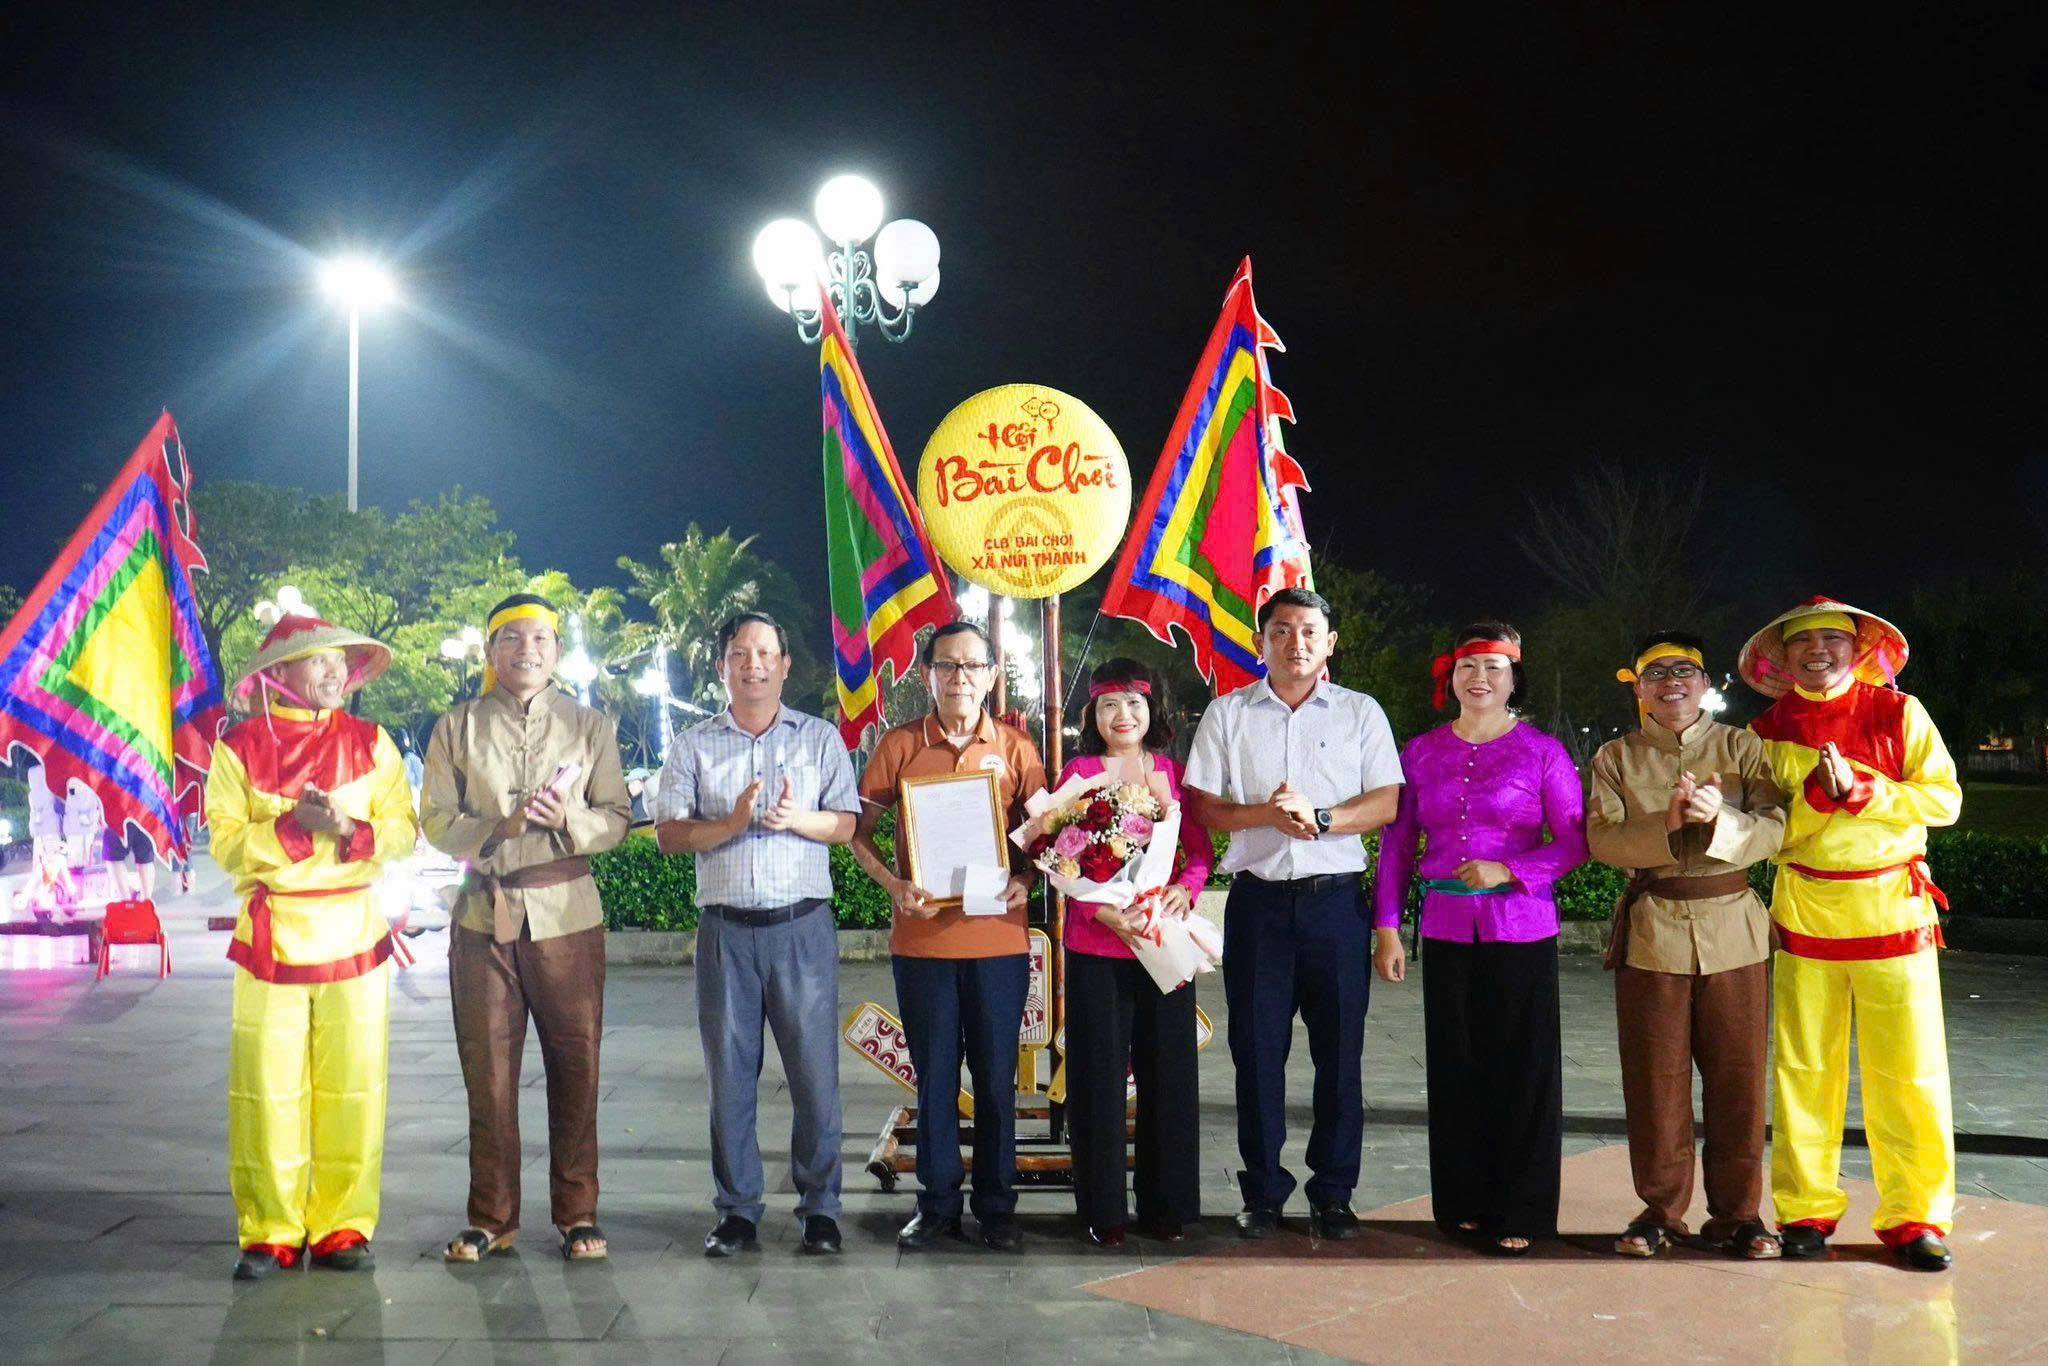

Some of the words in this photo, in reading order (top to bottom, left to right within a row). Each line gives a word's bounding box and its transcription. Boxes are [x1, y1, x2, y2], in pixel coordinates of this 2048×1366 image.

[978, 421, 1037, 453] Hội
[935, 455, 1026, 507] Bài
[1027, 442, 1117, 494] Chòi
[984, 537, 1010, 550] CLB
[1015, 532, 1038, 548] BÀI
[971, 552, 996, 570] XÃ
[1000, 549, 1028, 568] NÚI
[1031, 549, 1087, 568] THÀNH
